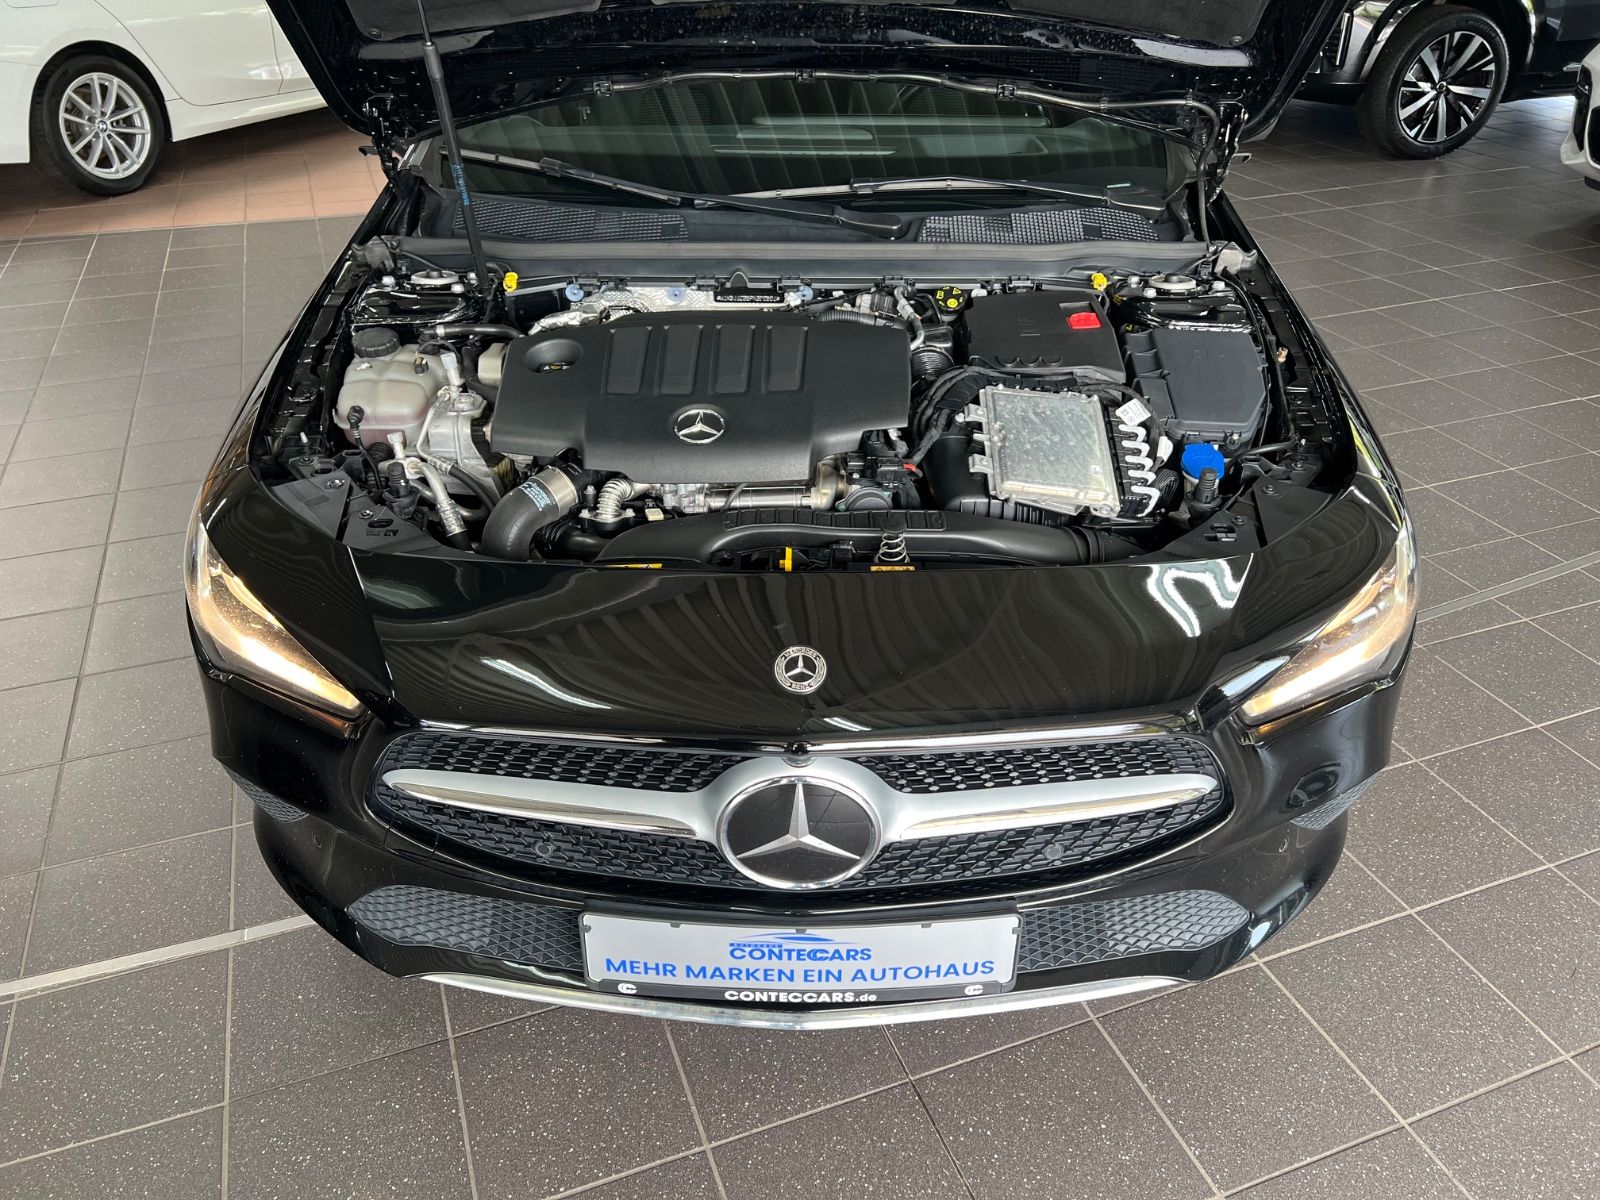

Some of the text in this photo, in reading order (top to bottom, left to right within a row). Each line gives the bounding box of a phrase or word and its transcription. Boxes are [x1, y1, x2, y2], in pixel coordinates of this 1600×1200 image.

[605, 958, 995, 983] MEHR MARKEN EIN AUTOHAUS
[724, 990, 877, 1003] CONTECCARS.de
